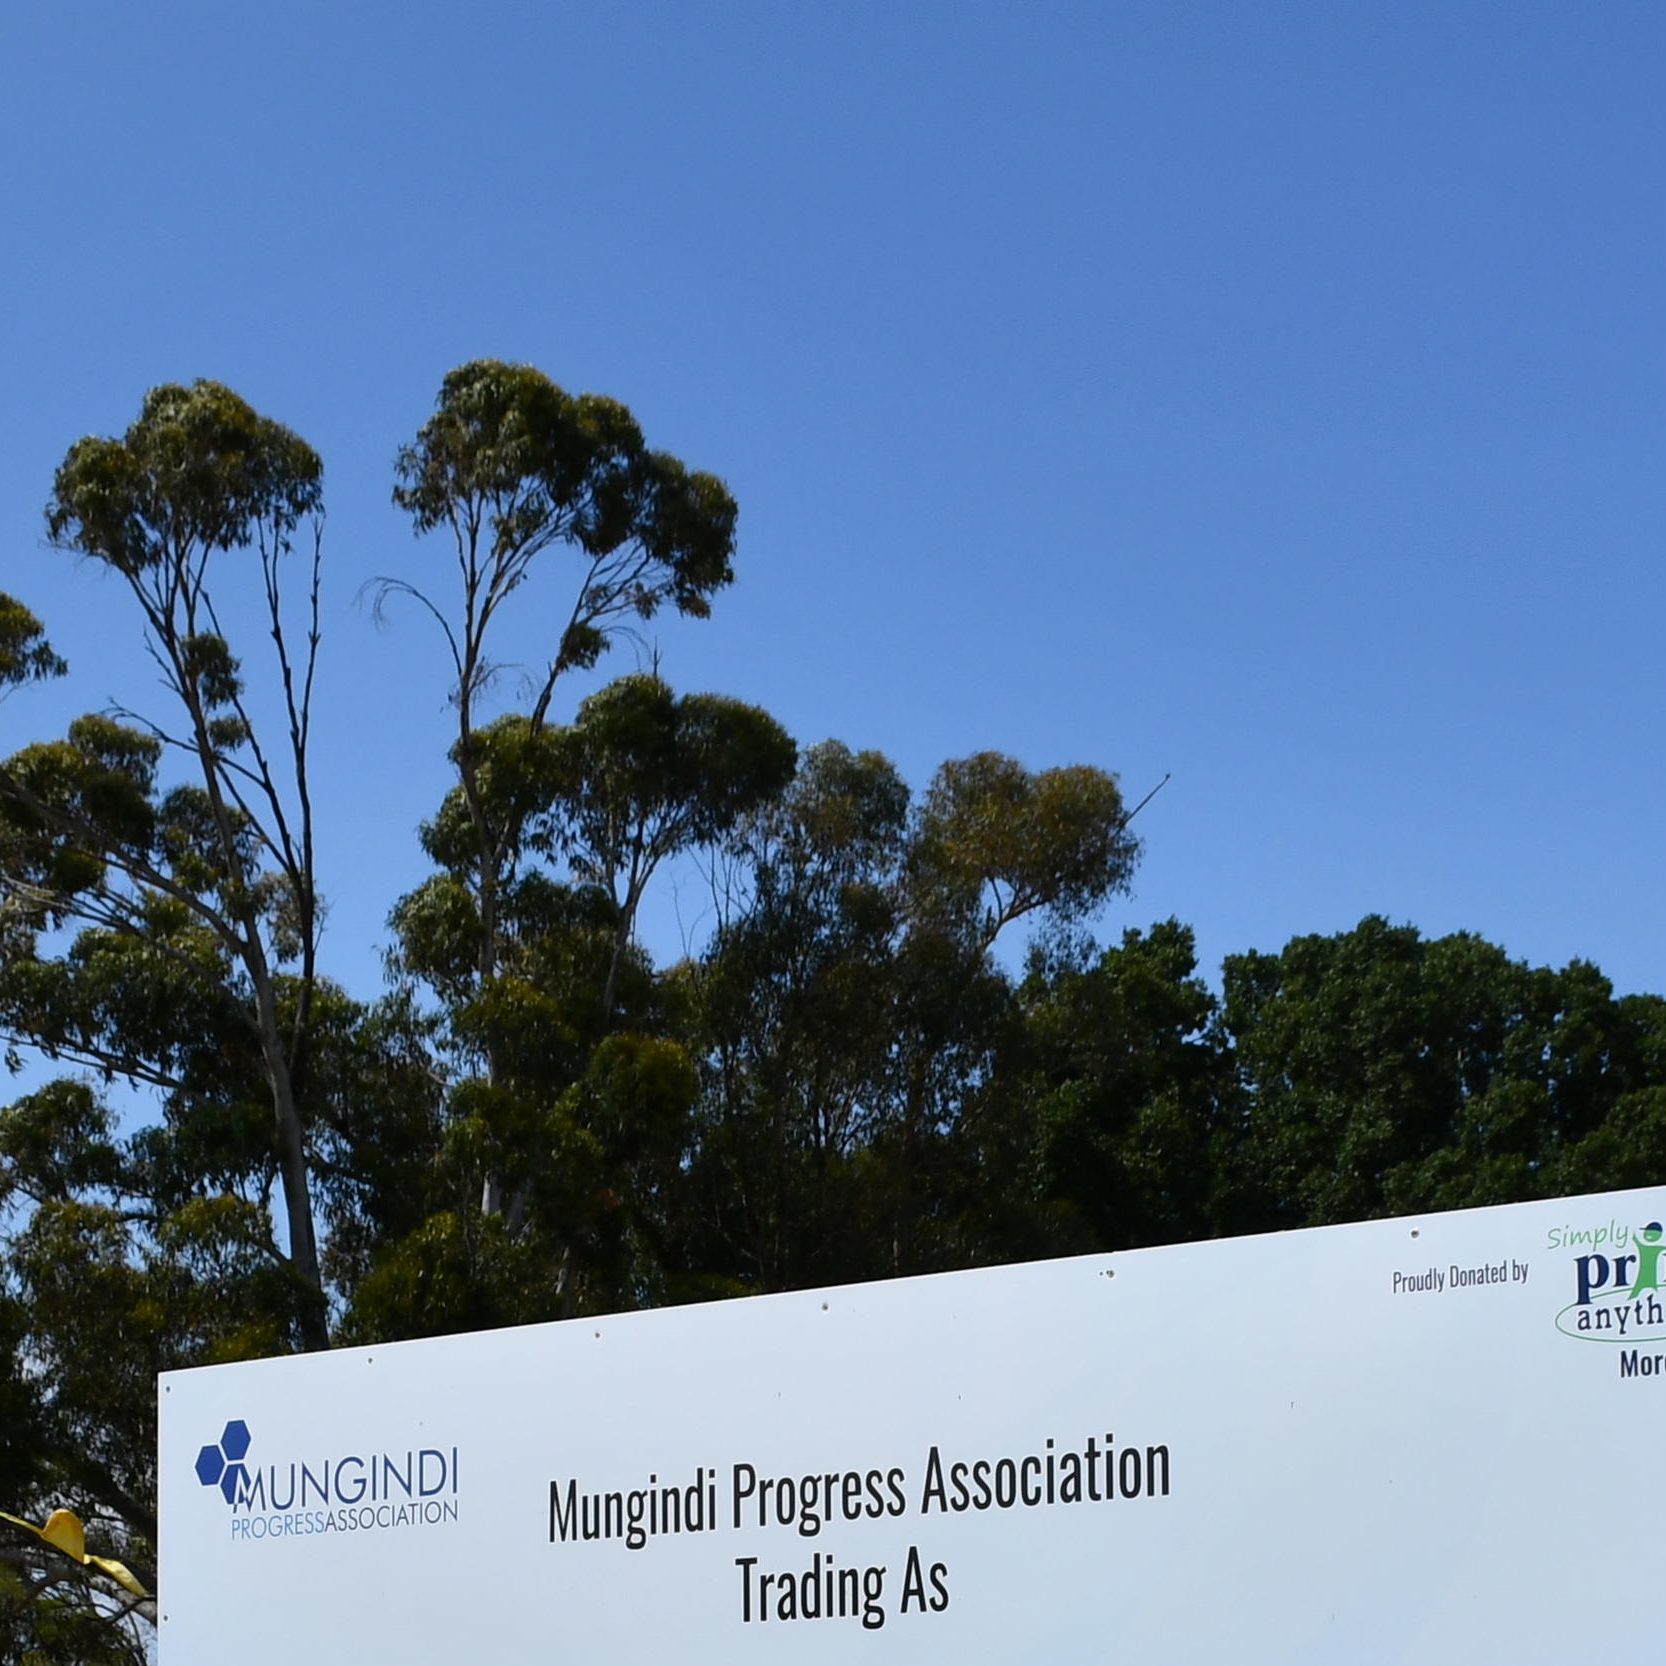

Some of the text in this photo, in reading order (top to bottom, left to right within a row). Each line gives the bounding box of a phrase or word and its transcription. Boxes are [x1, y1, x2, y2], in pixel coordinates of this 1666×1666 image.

[1547, 1219, 1629, 1252] Simply
[1393, 1259, 1529, 1294] Proudly Donated by
[232, 1446, 459, 1514] MUNGINDI
[549, 1433, 1171, 1549] Mungindi Progress Association
[735, 1546, 950, 1630] Trading As
